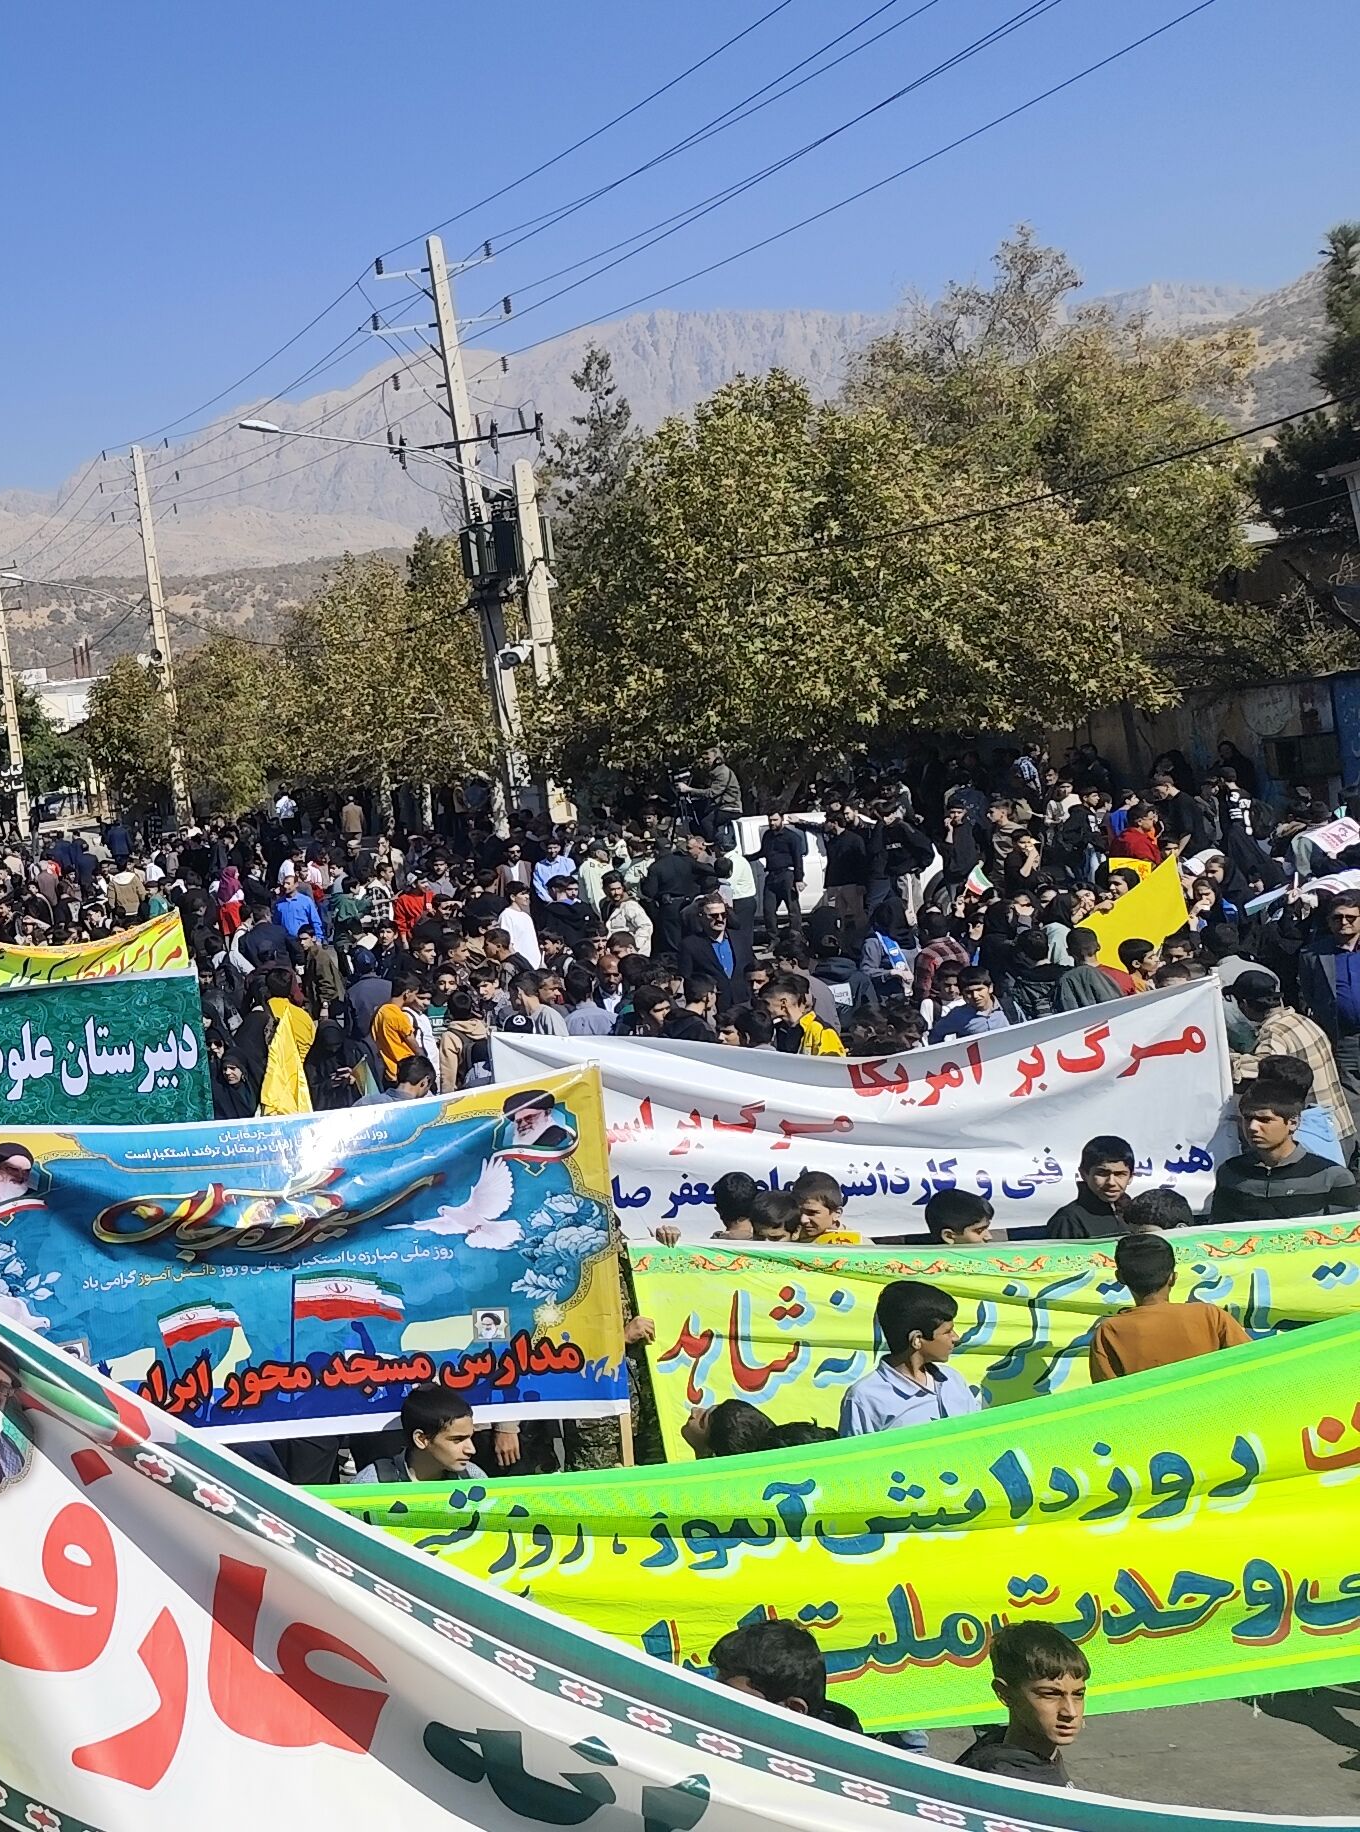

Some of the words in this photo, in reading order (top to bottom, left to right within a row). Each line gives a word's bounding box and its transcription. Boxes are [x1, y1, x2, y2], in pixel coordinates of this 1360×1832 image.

[61, 1017, 198, 1096] دبیرستان
[848, 1042, 984, 1106] امریکا
[1009, 1046, 1047, 1097] بر
[1057, 1022, 1207, 1077] مرگ
[713, 1098, 854, 1151] مرگ
[661, 1173, 717, 1219] عفر
[974, 1170, 993, 1200] و
[1002, 1147, 1063, 1200] فنی
[138, 1265, 174, 1287] آموز
[219, 1264, 241, 1278] روز
[293, 1252, 346, 1270] استکبار
[346, 1251, 357, 1264] با
[357, 1249, 399, 1266] مبارزه
[432, 1246, 454, 1260] روز
[81, 1275, 100, 1292] باد
[100, 1271, 136, 1291] گرامی
[442, 1329, 584, 1388] مدارس
[658, 1286, 805, 1405] شاهد
[224, 1355, 311, 1406] محور
[322, 1349, 435, 1398] مسجد
[816, 1449, 1079, 1556] دانش
[1079, 1436, 1260, 1523] روز
[488, 1505, 584, 1575] روز
[639, 1478, 817, 1571] آموز
[795, 1584, 992, 1682] ملت
